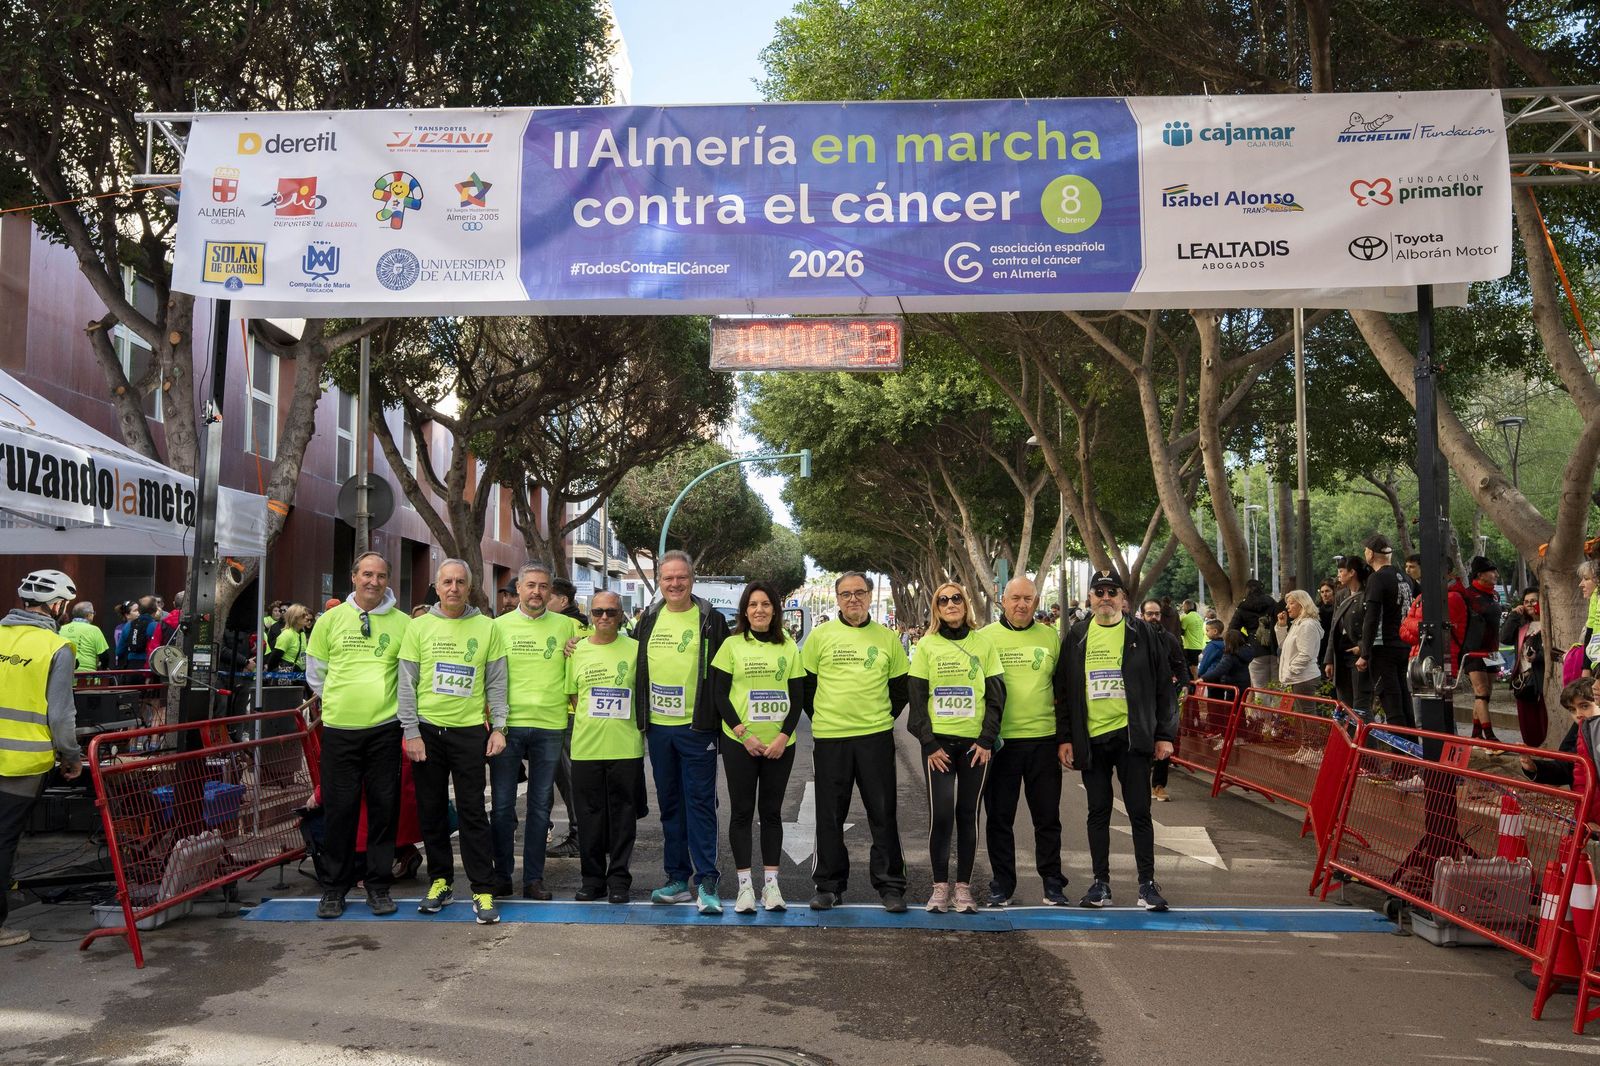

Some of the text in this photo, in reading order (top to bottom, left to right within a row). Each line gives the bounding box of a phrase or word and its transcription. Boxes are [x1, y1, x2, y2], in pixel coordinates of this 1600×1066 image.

[1200, 122, 1295, 146] cajamar
[1337, 125, 1494, 143] MICHELIN Fundación
[265, 131, 337, 154] deretil
[553, 120, 1101, 169] II Almería en marcha
[1269, 140, 1293, 148] RURAL
[1399, 173, 1479, 184] FUNDACIÓN
[1061, 185, 1081, 214] 8
[1163, 191, 1295, 207] Isabel Alonso
[1399, 183, 1483, 204] primaflor
[572, 182, 1021, 228] contra el cáncer
[198, 206, 246, 218] ALMERÍA
[446, 213, 500, 221] Almería 2005
[1395, 233, 1444, 246] Toyota
[990, 241, 1105, 254] asociación española
[1177, 240, 1290, 260] LEALTADIS
[1395, 244, 1500, 260] Alborán Motor
[421, 258, 506, 270] UNIVERSIDAD
[789, 250, 864, 278] 2026
[992, 255, 1082, 266] contra el cáncer
[1202, 261, 1265, 270] ABOGADOS
[210, 262, 258, 274] DE CABRAS
[420, 268, 505, 281] DE ALMERÍA
[570, 259, 731, 277] #TodosContraElCáncer
[992, 268, 1057, 279] en Almería
[289, 281, 323, 289] Compañía
[332, 281, 351, 289] María
[437, 673, 473, 689] 1442
[596, 698, 622, 711] 571
[652, 693, 682, 709] 1253
[751, 701, 788, 714] 1800
[936, 697, 973, 709] 1402
